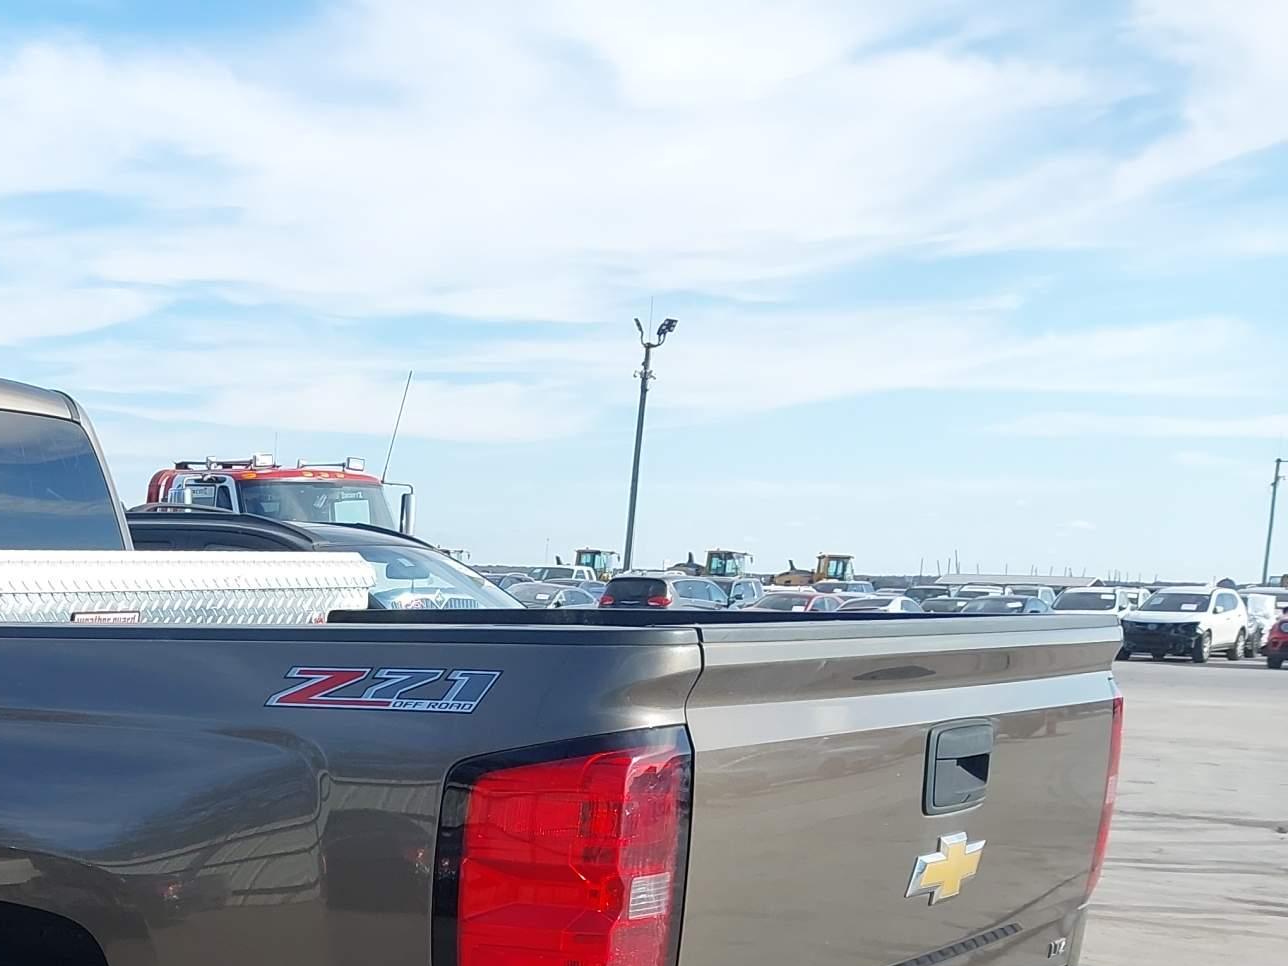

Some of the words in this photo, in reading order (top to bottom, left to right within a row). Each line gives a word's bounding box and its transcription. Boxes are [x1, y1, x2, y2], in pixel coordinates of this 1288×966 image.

[264, 666, 503, 714] Z71
[392, 701, 425, 710] OFF
[426, 702, 475, 711] ROAD
